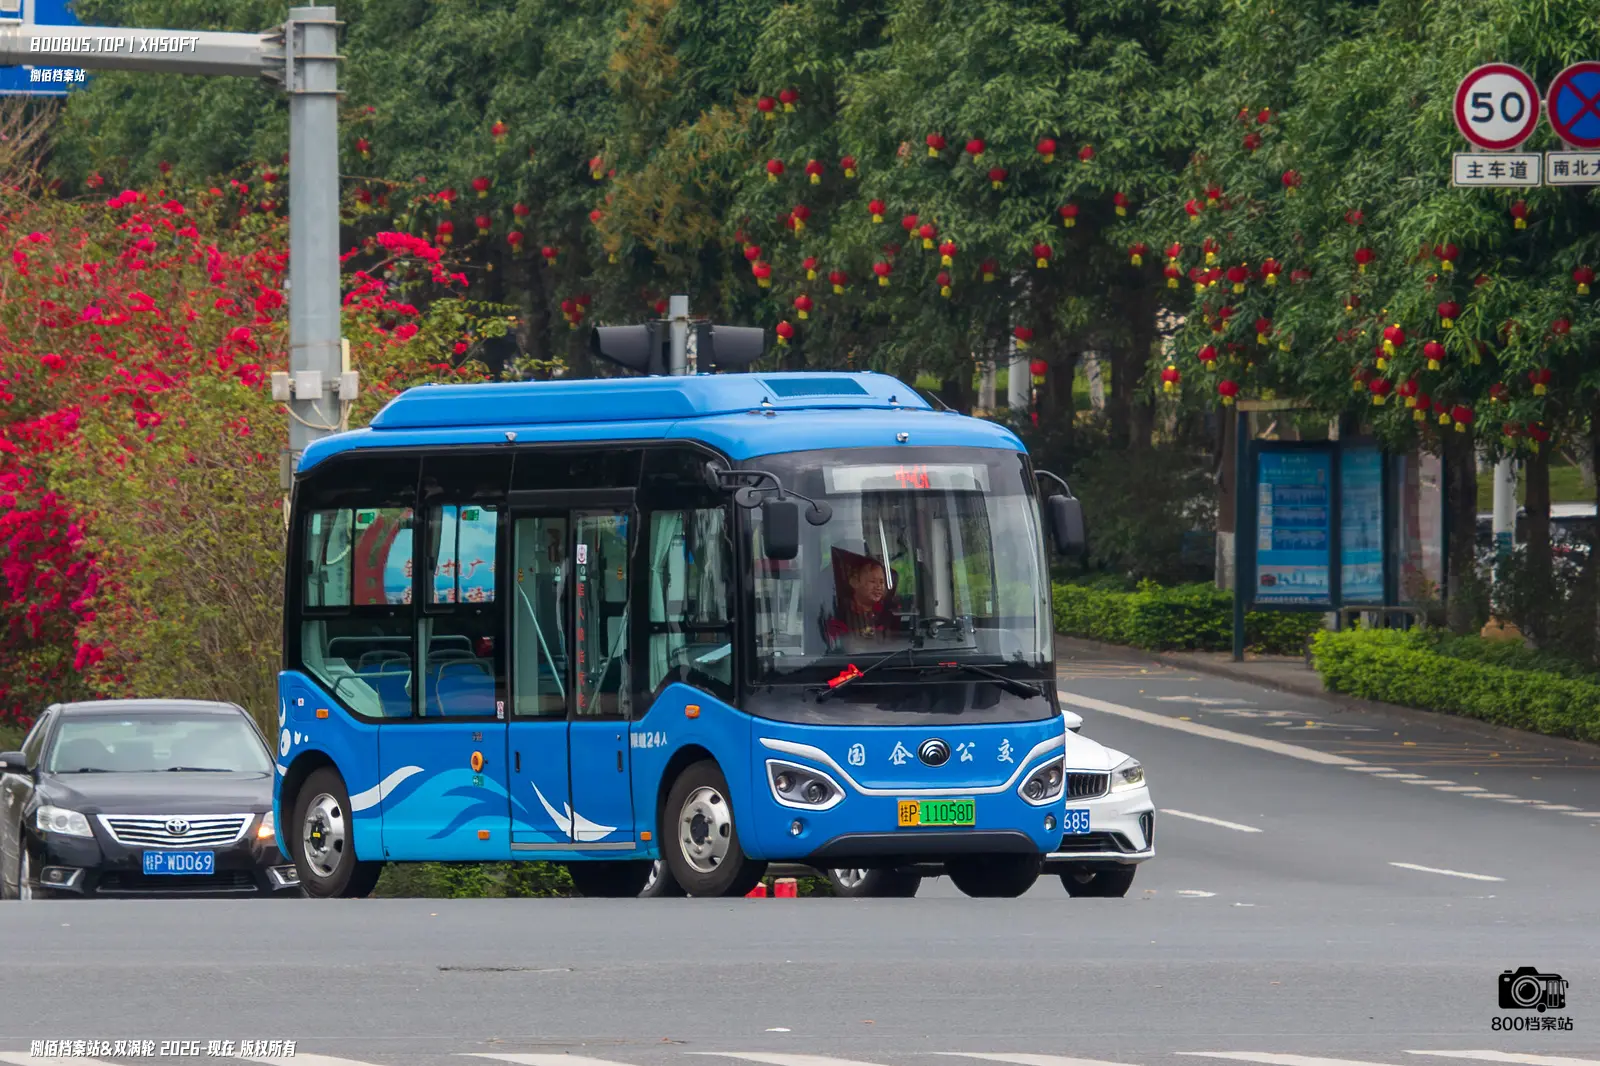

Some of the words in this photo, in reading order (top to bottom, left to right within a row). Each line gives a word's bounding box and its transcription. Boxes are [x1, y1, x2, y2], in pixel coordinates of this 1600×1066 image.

[1471, 92, 1525, 123] 50
[1466, 161, 1528, 180] 主车道
[847, 738, 1014, 767] 国企公交
[1063, 811, 1089, 830] 685
